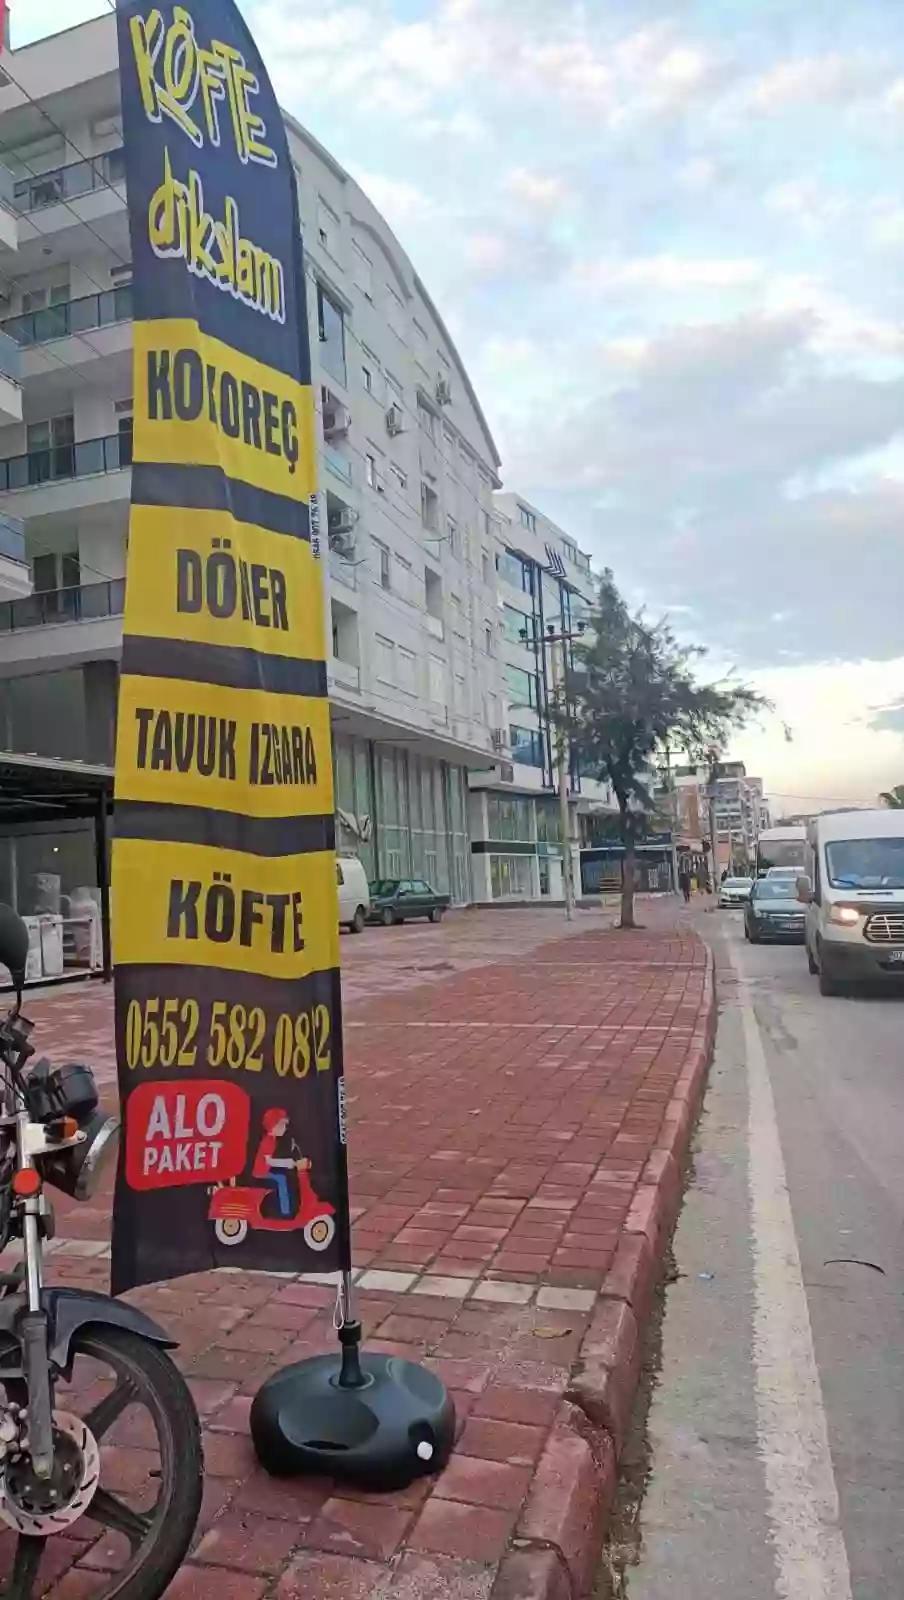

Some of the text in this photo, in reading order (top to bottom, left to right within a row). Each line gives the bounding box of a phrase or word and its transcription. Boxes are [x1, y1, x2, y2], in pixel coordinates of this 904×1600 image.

[129, 7, 278, 169] KÖFTE
[176, 537, 289, 631] DÖNER
[135, 707, 317, 785] TAVUK IZGARA
[166, 871, 305, 953] KÖFTE
[126, 998, 200, 1070] 0552
[207, 1002, 266, 1072] 582
[146, 1092, 226, 1141] ALO
[143, 1141, 224, 1176] PAKET
